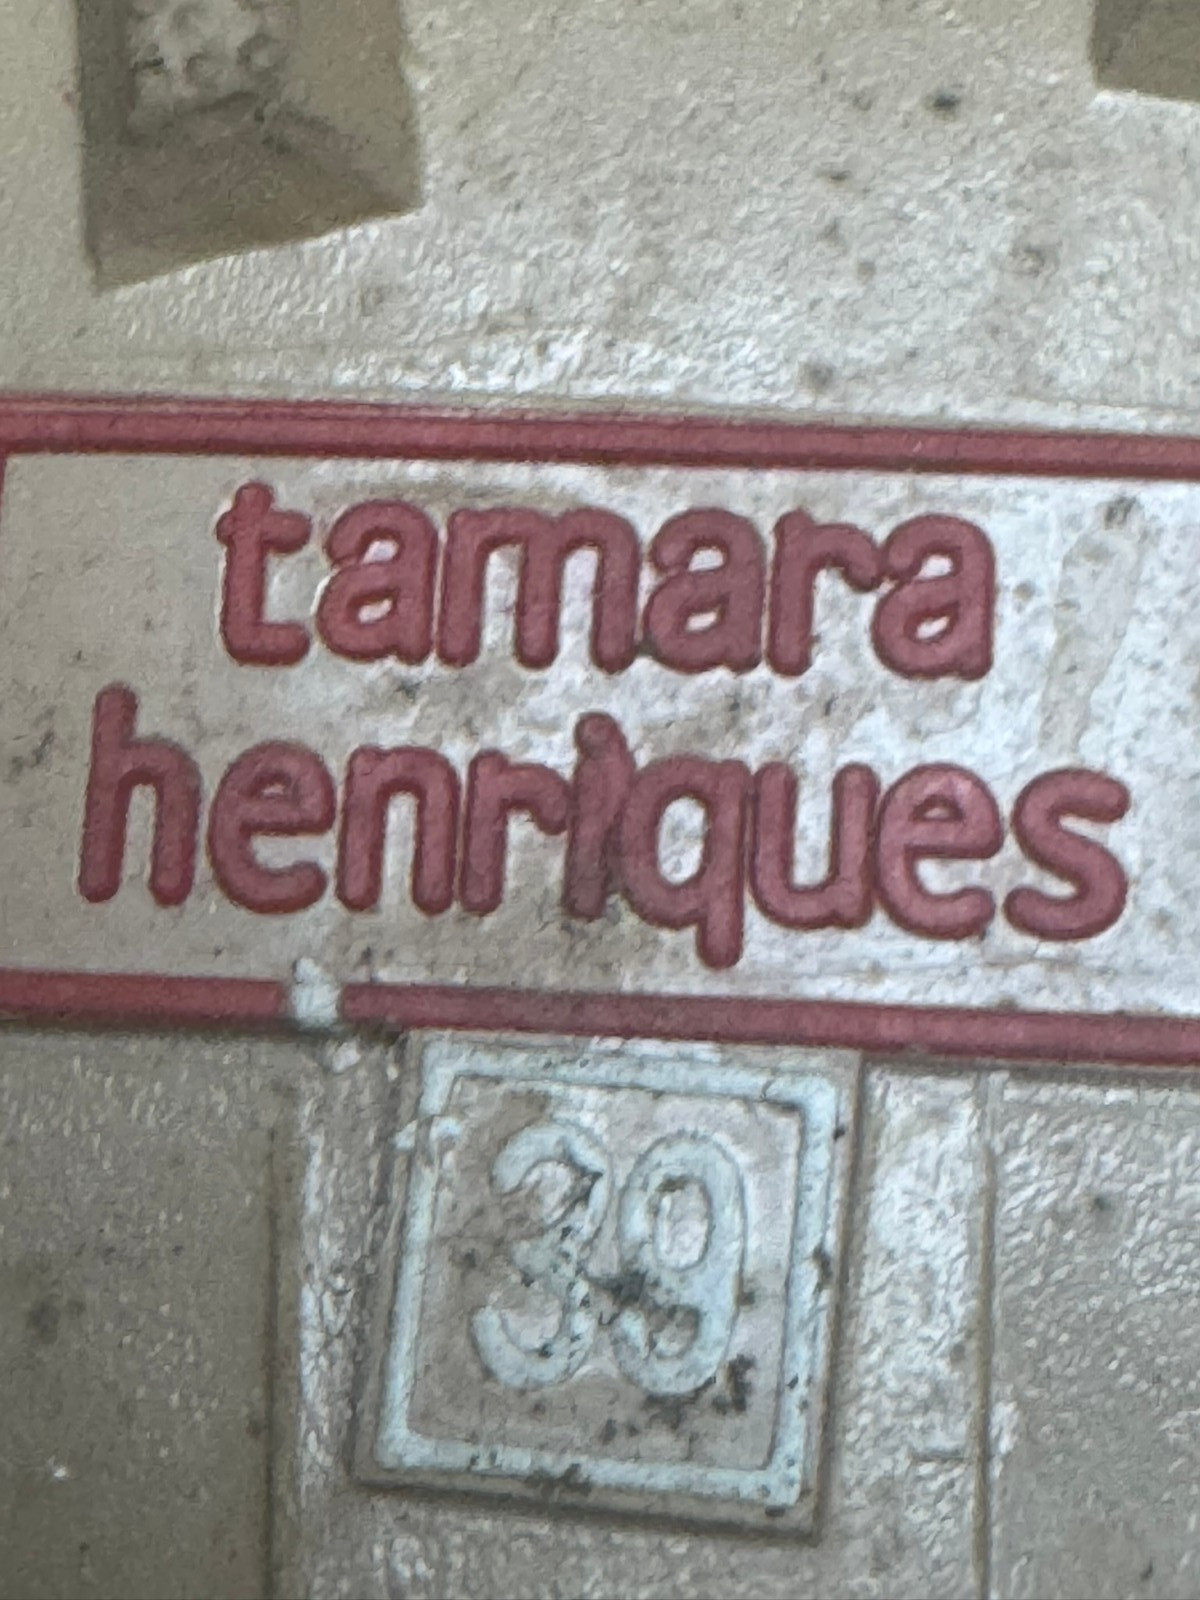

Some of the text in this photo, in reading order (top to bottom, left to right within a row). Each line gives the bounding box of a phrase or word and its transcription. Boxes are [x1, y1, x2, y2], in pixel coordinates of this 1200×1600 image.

[215, 482, 995, 677] tamara
[78, 683, 1130, 970] henriques
[473, 1124, 747, 1395] 39
